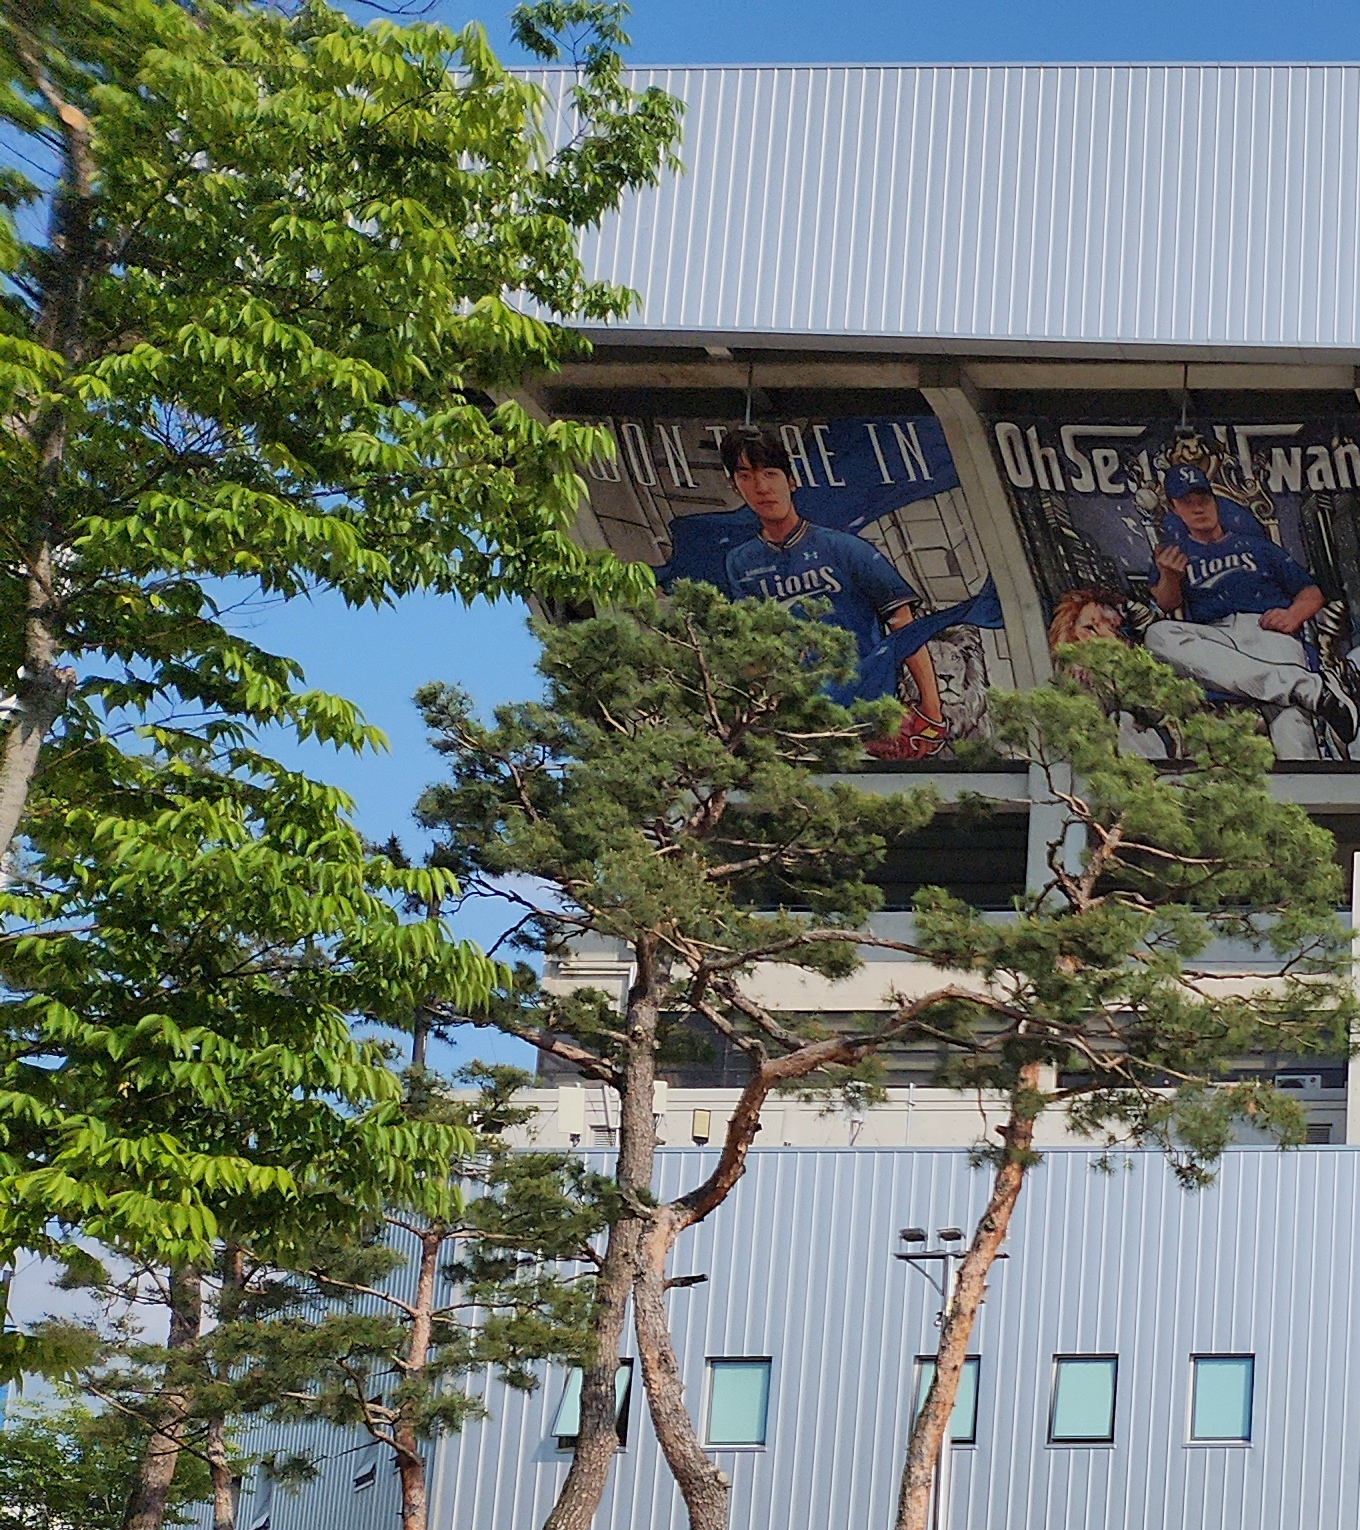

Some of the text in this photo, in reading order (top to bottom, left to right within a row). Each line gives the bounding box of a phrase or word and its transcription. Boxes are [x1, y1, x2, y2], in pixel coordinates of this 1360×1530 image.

[862, 421, 934, 485] IN
[759, 565, 842, 601] Lions
[1186, 552, 1257, 587] Lions
